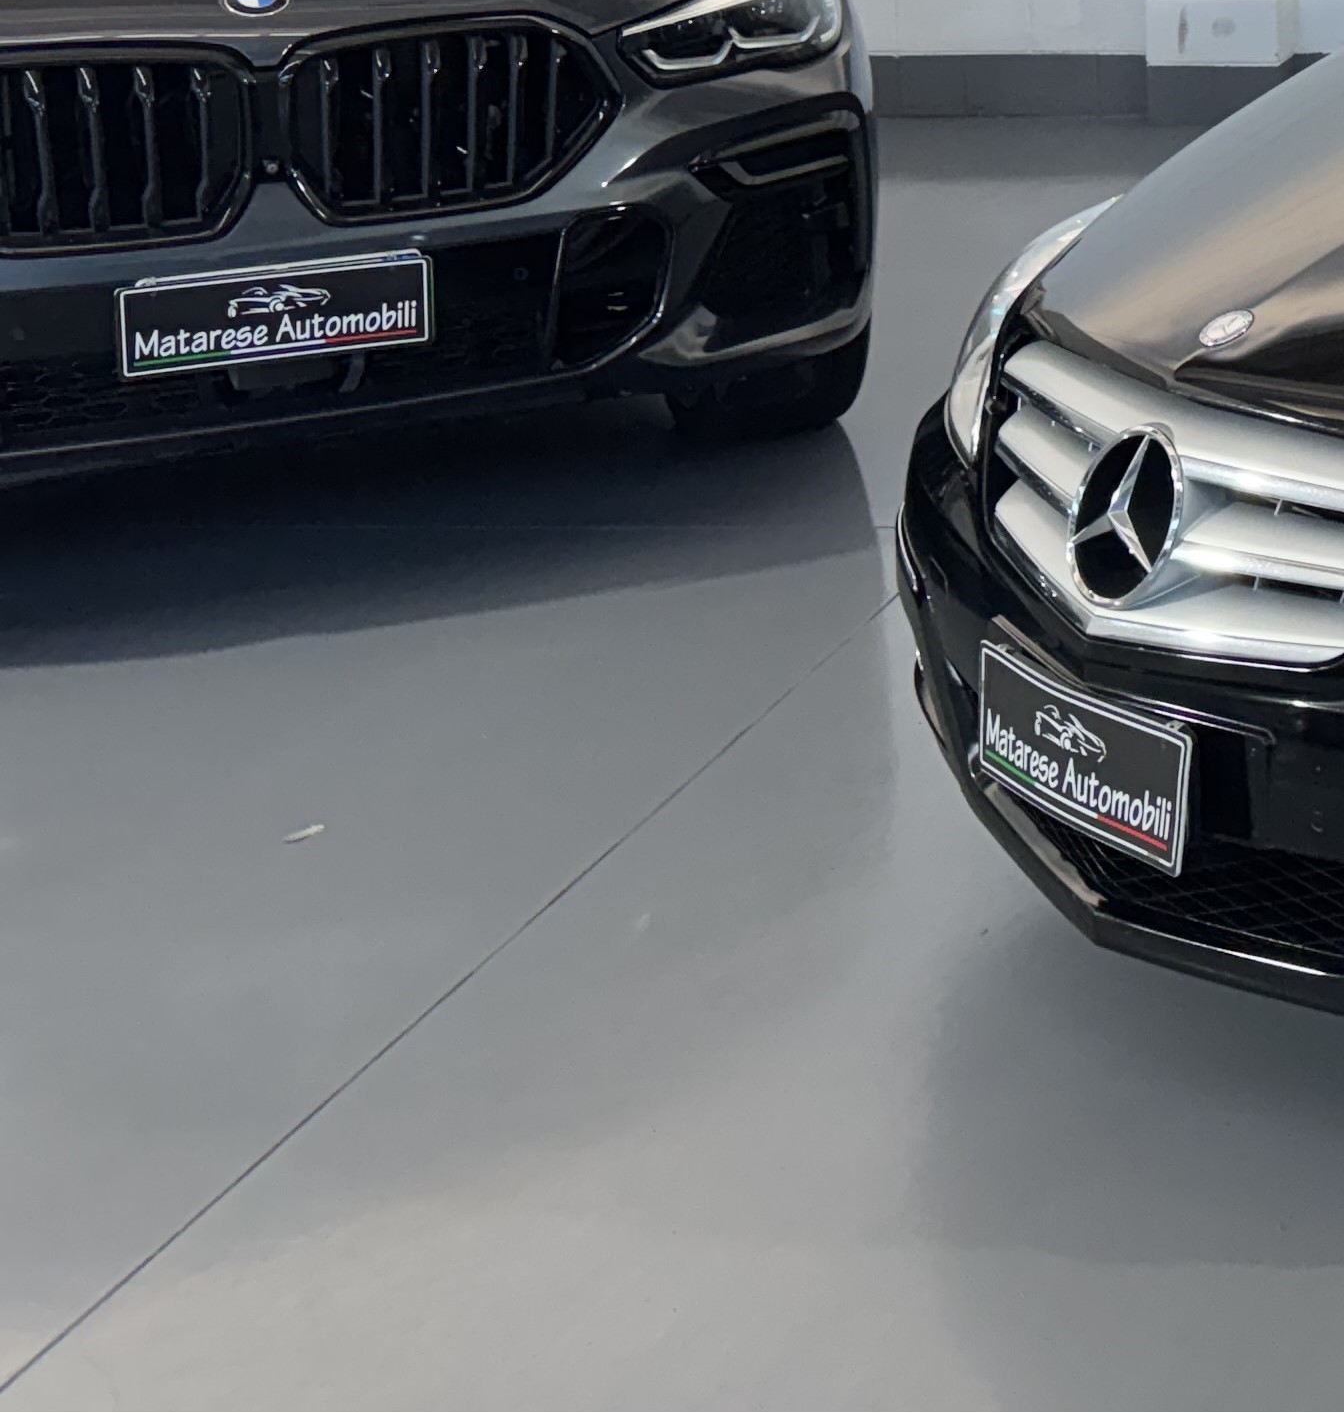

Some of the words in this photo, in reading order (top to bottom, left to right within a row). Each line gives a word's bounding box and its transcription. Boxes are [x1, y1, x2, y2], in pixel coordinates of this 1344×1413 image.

[134, 324, 269, 360] Matarese
[275, 299, 418, 343] Automobili
[985, 707, 1059, 789] Matarese
[1062, 757, 1173, 841] Automobili
